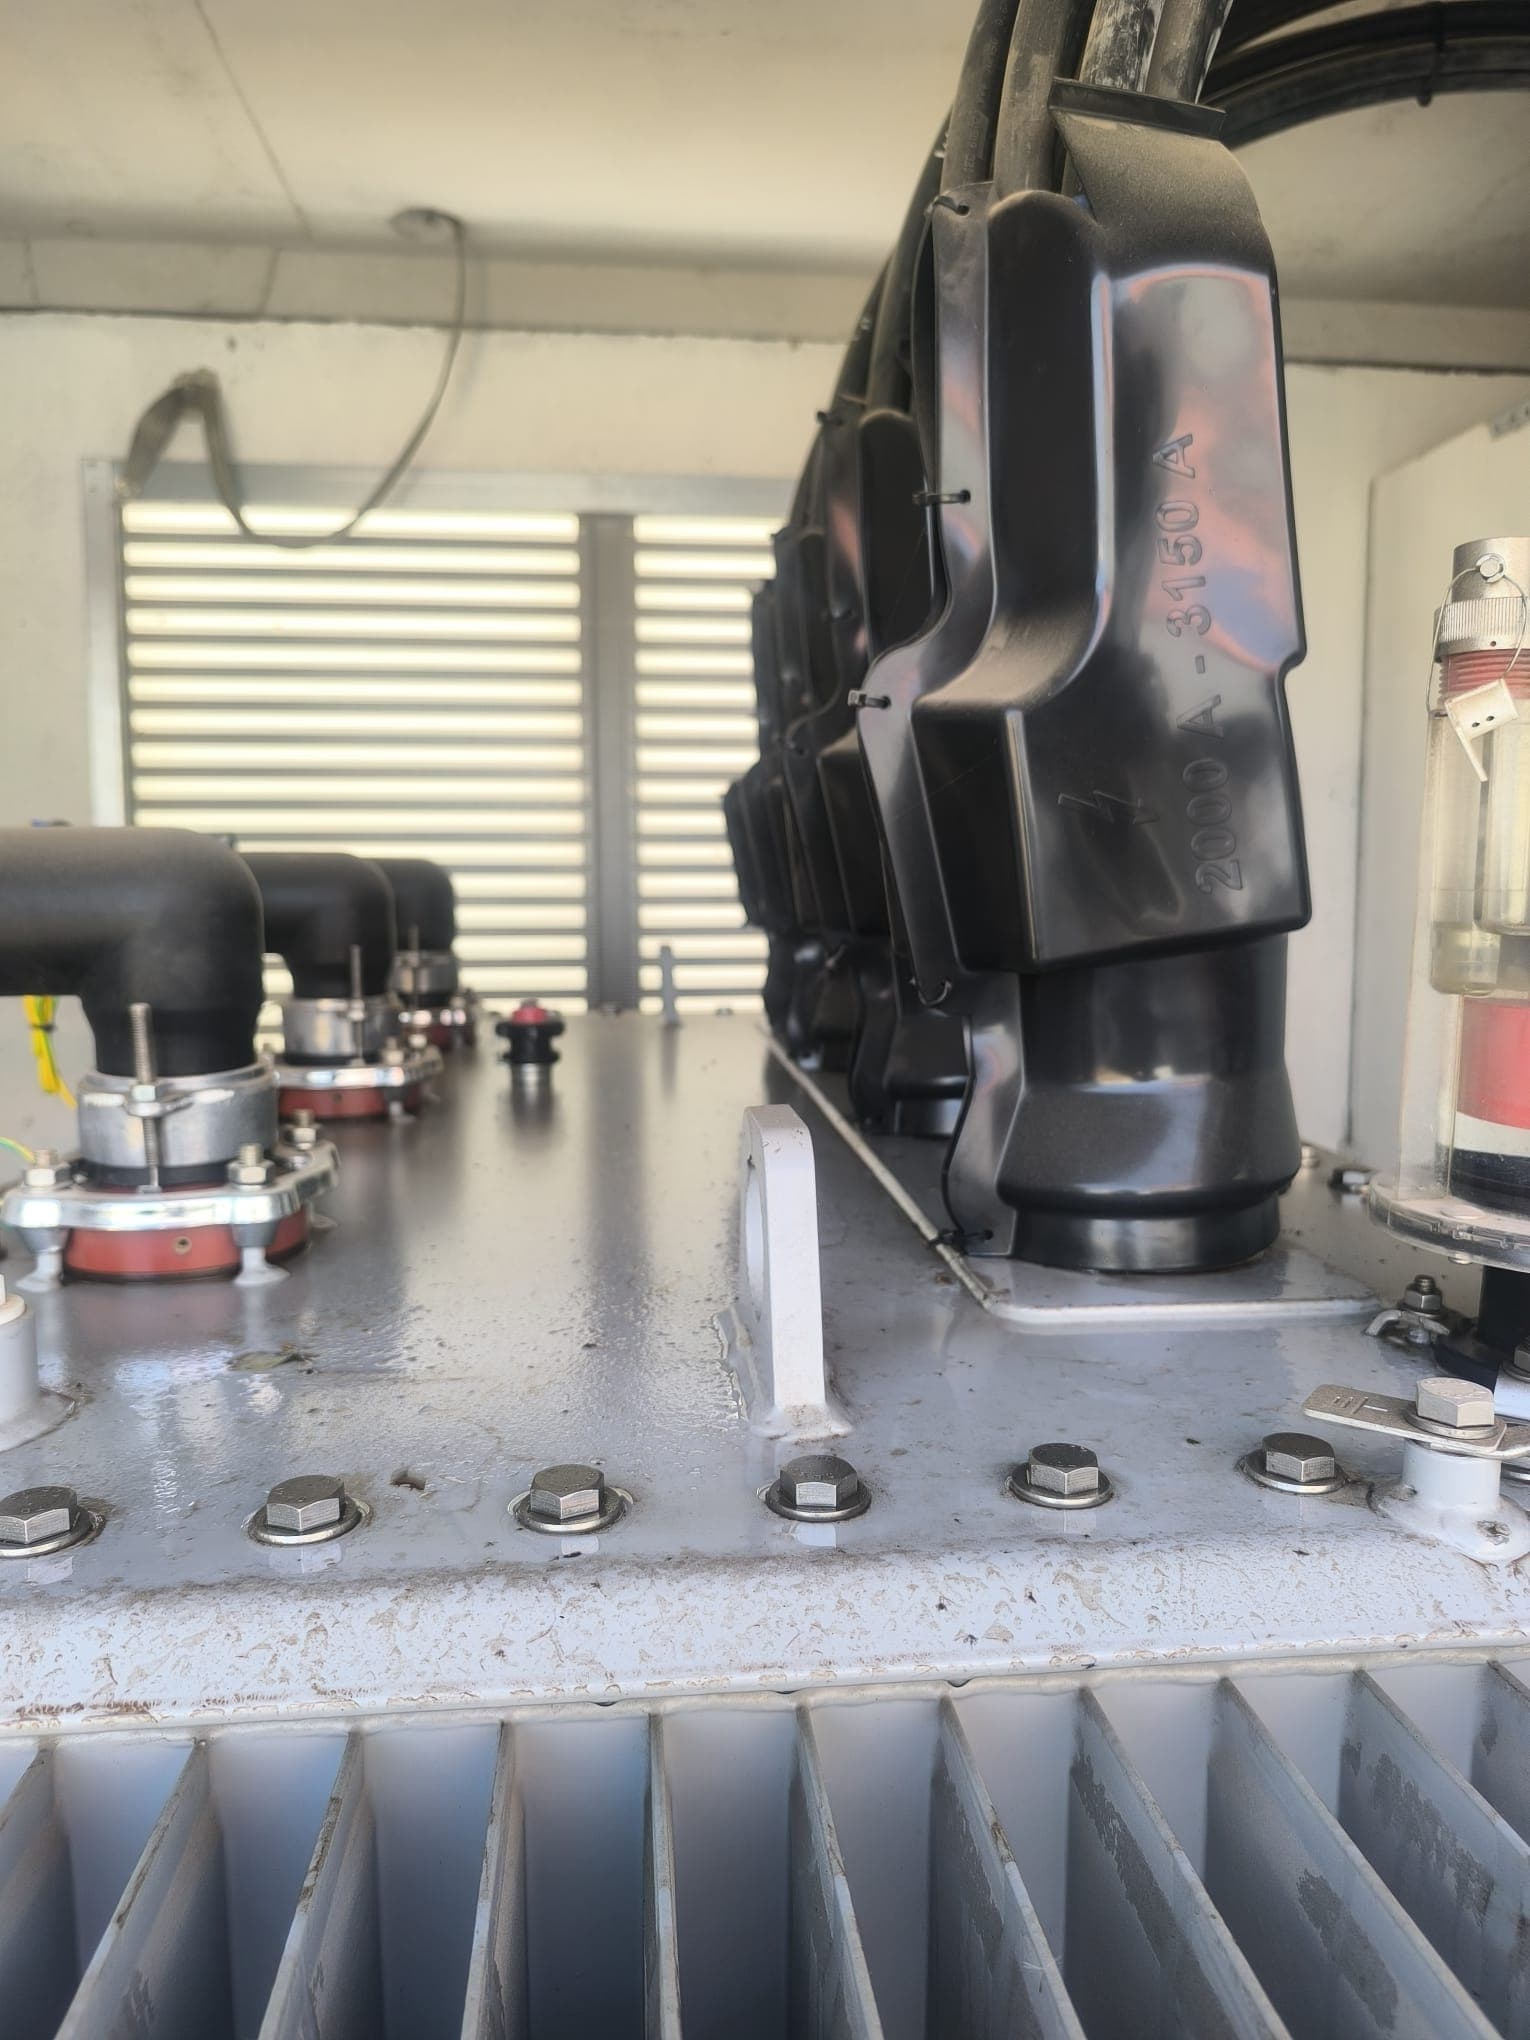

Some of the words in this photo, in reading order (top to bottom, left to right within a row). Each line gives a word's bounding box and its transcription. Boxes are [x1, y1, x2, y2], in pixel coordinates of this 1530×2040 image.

[1152, 433, 1196, 479] A
[1154, 499, 1212, 638] 3150
[1182, 757, 1245, 895] 2000
